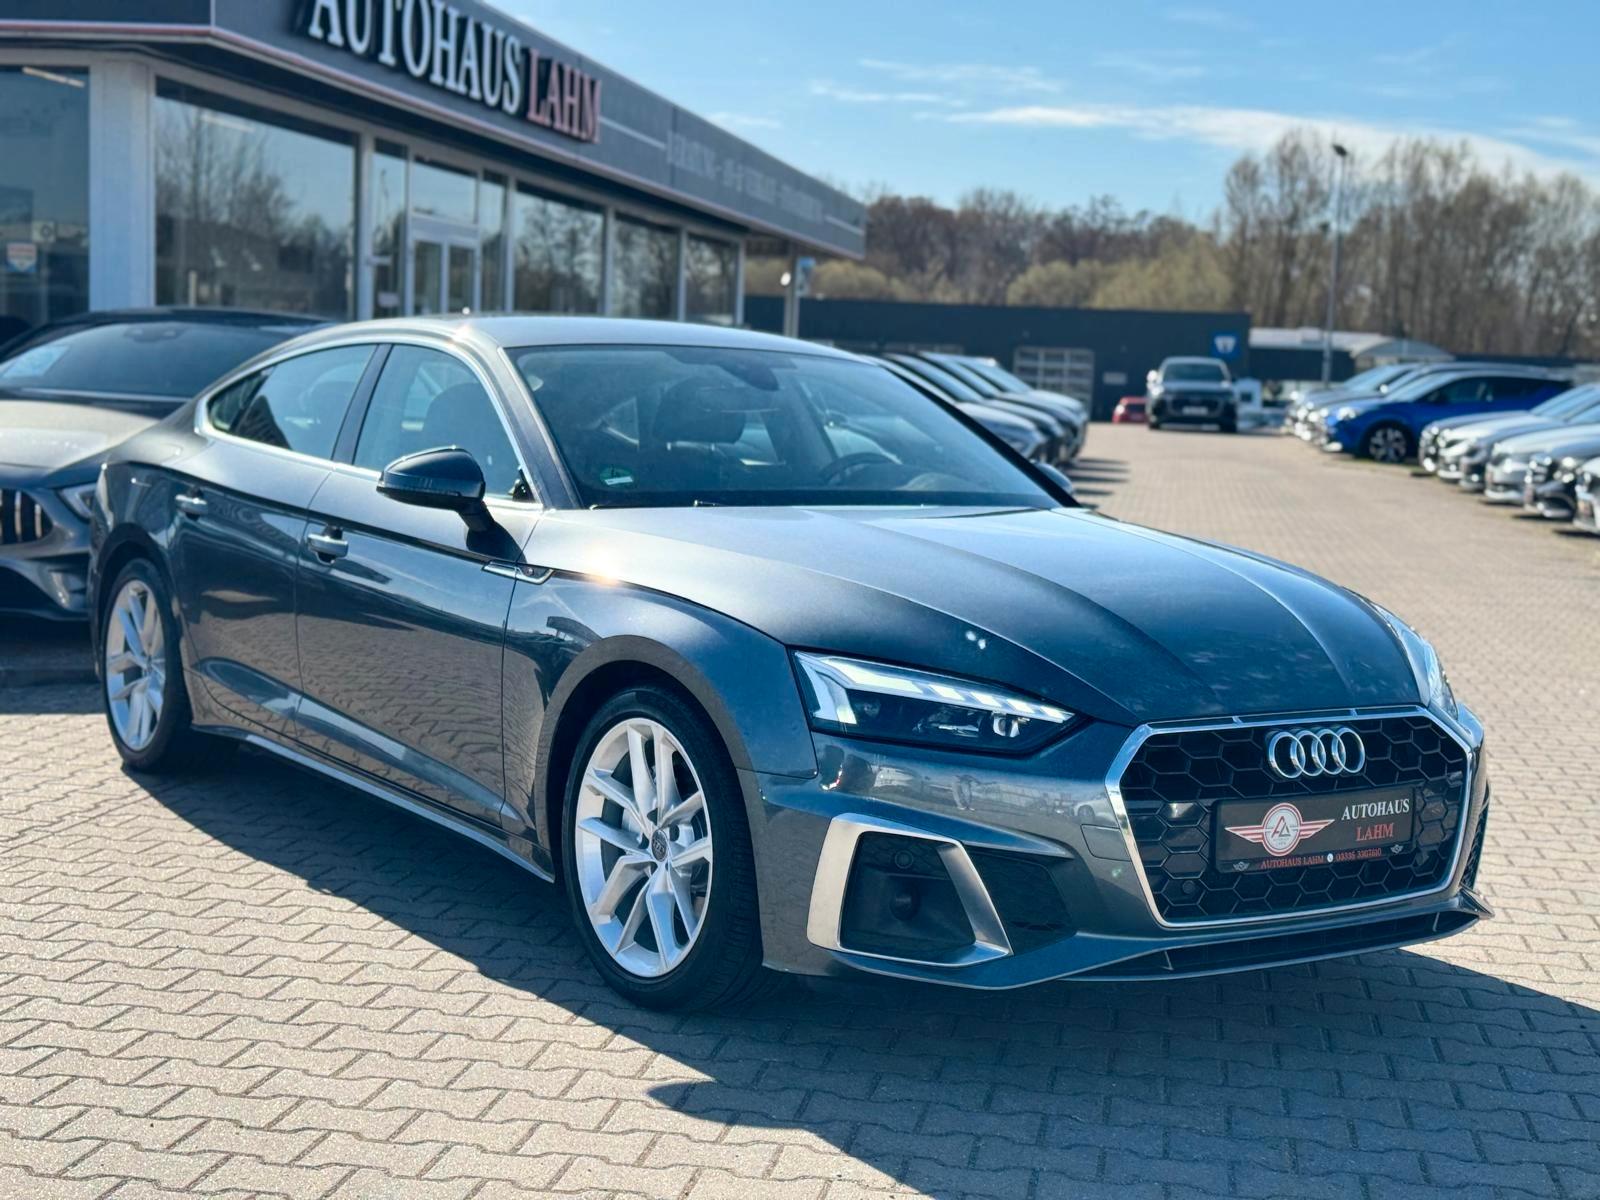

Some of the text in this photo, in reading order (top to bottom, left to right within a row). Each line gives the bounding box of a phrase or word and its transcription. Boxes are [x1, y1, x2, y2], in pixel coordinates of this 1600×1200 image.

[308, 0, 600, 144] AUTOHAUS LAHM
[1341, 798, 1410, 821] AUTOHAUS
[1356, 822, 1394, 842] LAHM
[1260, 857, 1302, 869] AUTOHAUS
[1303, 855, 1324, 865] LAHM
